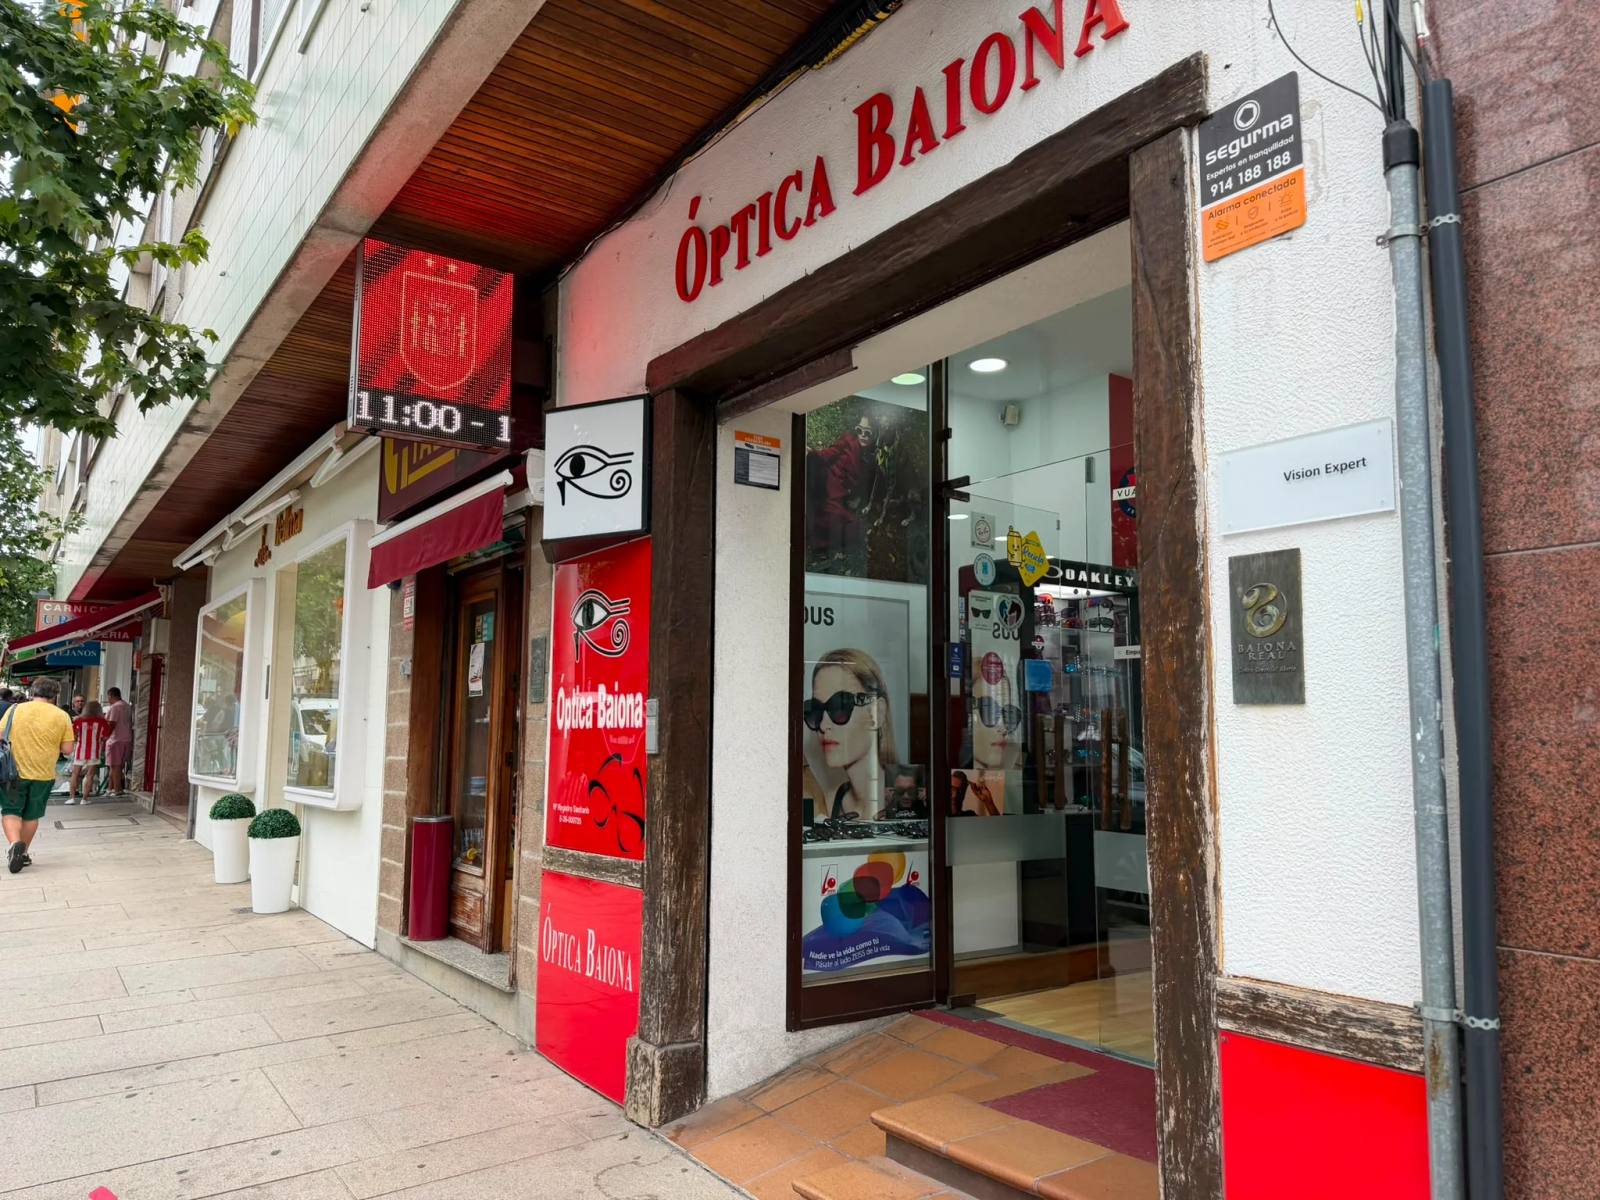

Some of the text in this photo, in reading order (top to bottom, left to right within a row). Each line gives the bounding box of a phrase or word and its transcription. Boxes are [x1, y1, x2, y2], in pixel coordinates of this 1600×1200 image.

[675, 0, 1130, 302] ÓPTICA BAIONA
[1205, 113, 1294, 166] segurma
[1206, 134, 1295, 181] Expertos en tranquilidad
[1210, 151, 1292, 197] 914 188 188
[1207, 177, 1297, 221] Alarma conectada
[356, 391, 462, 434] 11:00
[1283, 456, 1368, 482] Vision Expert
[1065, 568, 1134, 587] OAKLEY
[1238, 641, 1297, 653] BAIONA
[1248, 651, 1285, 661] REAL
[556, 673, 643, 739] Óptica Baiona
[543, 902, 633, 992] ÓPTICA BAIONA
[809, 951, 828, 960] Nadie
[842, 945, 855, 954] vida
[856, 940, 872, 949] como
[872, 936, 880, 945] tú
[851, 950, 866, 961] ZEISS
